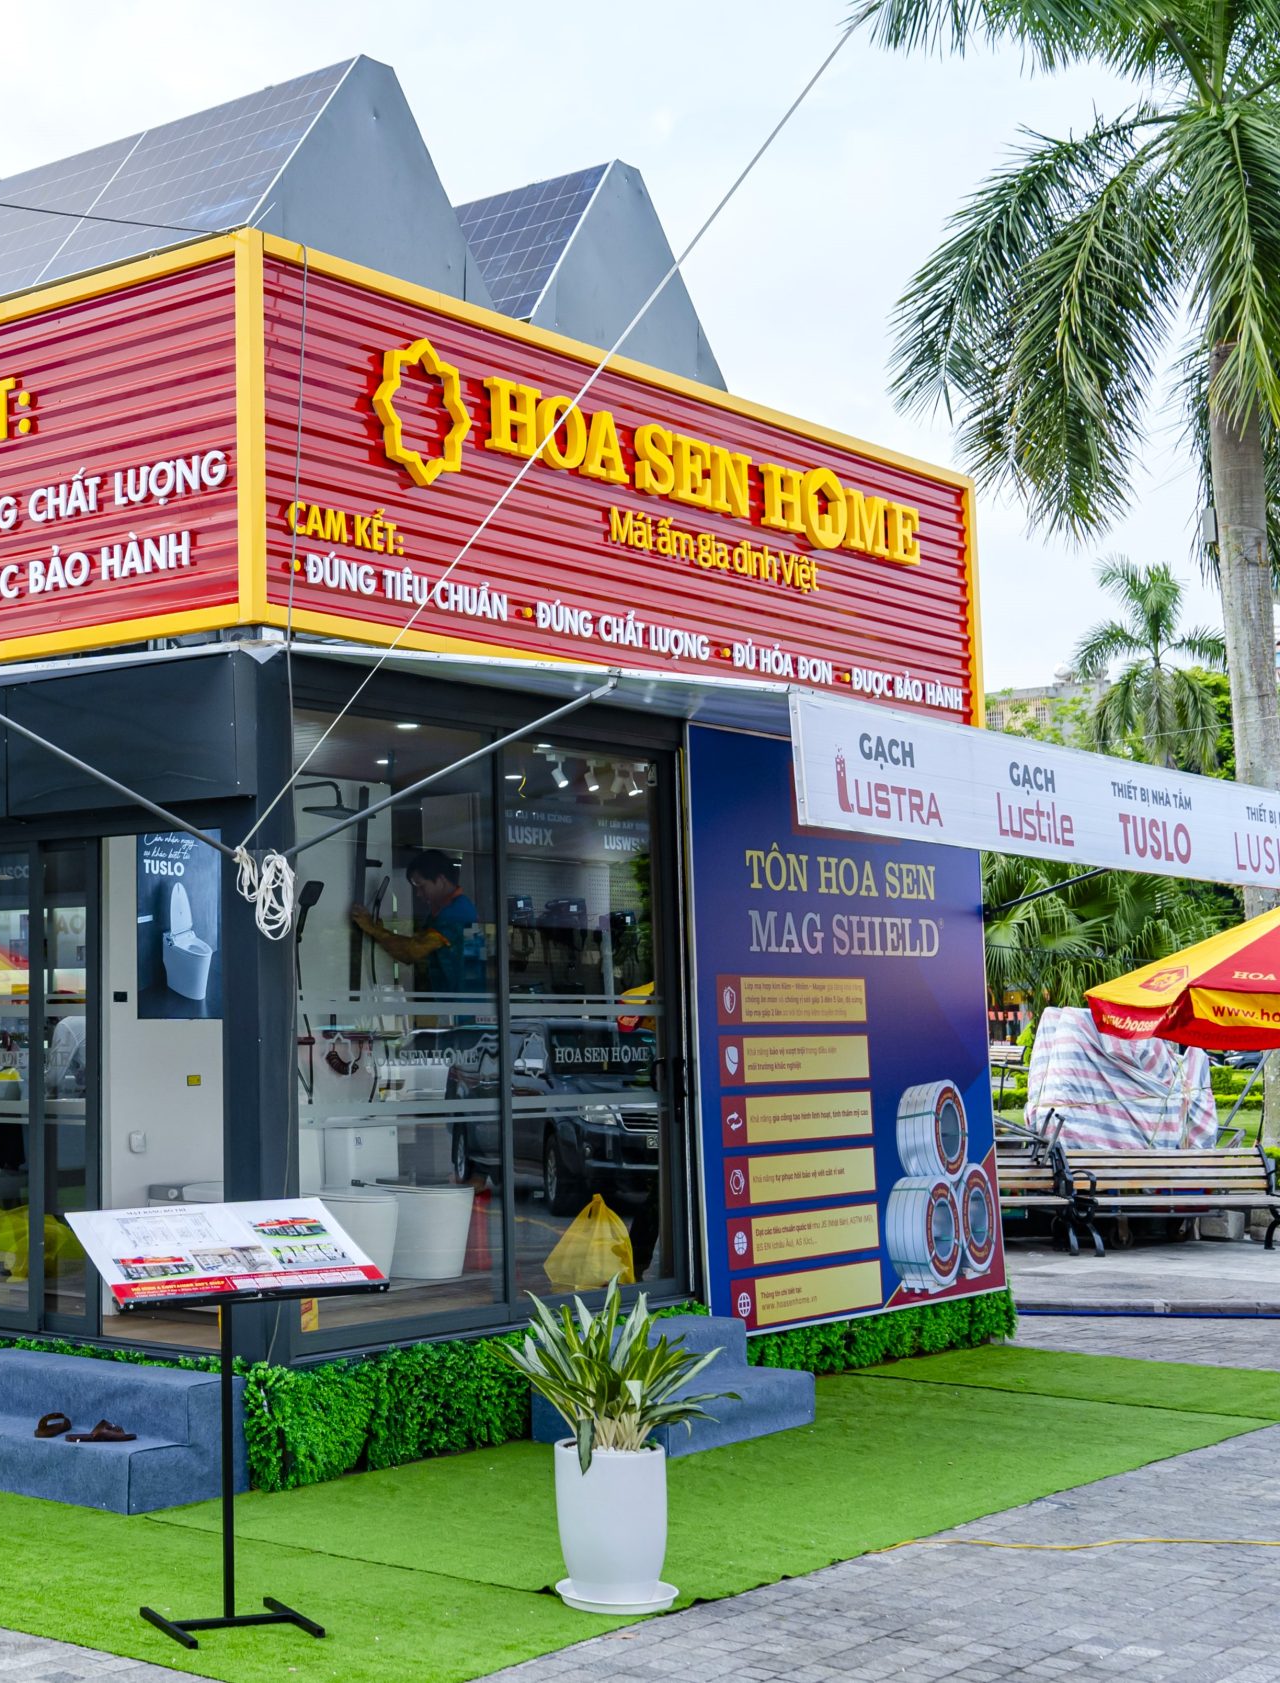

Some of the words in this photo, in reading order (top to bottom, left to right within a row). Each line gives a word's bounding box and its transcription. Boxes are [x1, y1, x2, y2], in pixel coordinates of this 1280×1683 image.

[27, 466, 101, 523] CHẤT
[113, 449, 228, 507] LƯỢNG
[483, 374, 630, 485] HOA
[634, 422, 752, 519] SEN
[759, 462, 921, 566] HOME
[287, 500, 348, 547] CAM
[353, 505, 405, 556] KẾT:
[609, 505, 654, 552] Mái
[656, 516, 696, 561] ấm
[698, 533, 731, 573] gia
[731, 537, 779, 582] đình
[781, 550, 821, 595] Việt
[28, 544, 90, 595] BẢO
[100, 530, 191, 581] HÀNH
[306, 550, 376, 596] ĐÚNG
[382, 564, 431, 605] TIÊU
[432, 578, 509, 623] CHUẨN
[536, 597, 593, 638] ĐÚNG
[598, 608, 646, 649] CHẤT
[649, 625, 711, 663] LƯỢNG
[733, 639, 756, 670] ĐỦ
[798, 655, 833, 685] ĐƠN
[851, 667, 892, 698] ĐƯỢC
[896, 670, 923, 702] BẢO
[926, 676, 963, 709] HÀNH
[858, 732, 915, 771] GẠCH
[1009, 761, 1056, 796] GẠCH
[1111, 779, 1137, 801] THIẾT
[1140, 788, 1150, 808] BỊ
[1152, 789, 1171, 808] NHÀ
[1172, 788, 1192, 811] TẮM
[1246, 803, 1267, 823] THIẾT
[1269, 810, 1277, 829] BỊ
[507, 825, 554, 847] LUSFIX
[604, 834, 649, 852] LUSWE
[834, 752, 944, 828] LUSTRA
[996, 791, 1075, 847] Lustile
[1118, 812, 1192, 865] TUSLO
[1234, 831, 1280, 875] LUS
[143, 859, 185, 876] TUSLO
[745, 841, 809, 892] TÔN
[816, 856, 879, 897] HOA
[884, 861, 936, 901] SEN
[748, 909, 825, 955] MAG
[832, 913, 940, 958] SHIELD
[1232, 970, 1277, 981] HOA
[1212, 1005, 1280, 1022] www.ho
[399, 1050, 428, 1066] SEN
[555, 1048, 583, 1063] HOA
[584, 1047, 609, 1063] SEN
[611, 1045, 650, 1063] HOME
